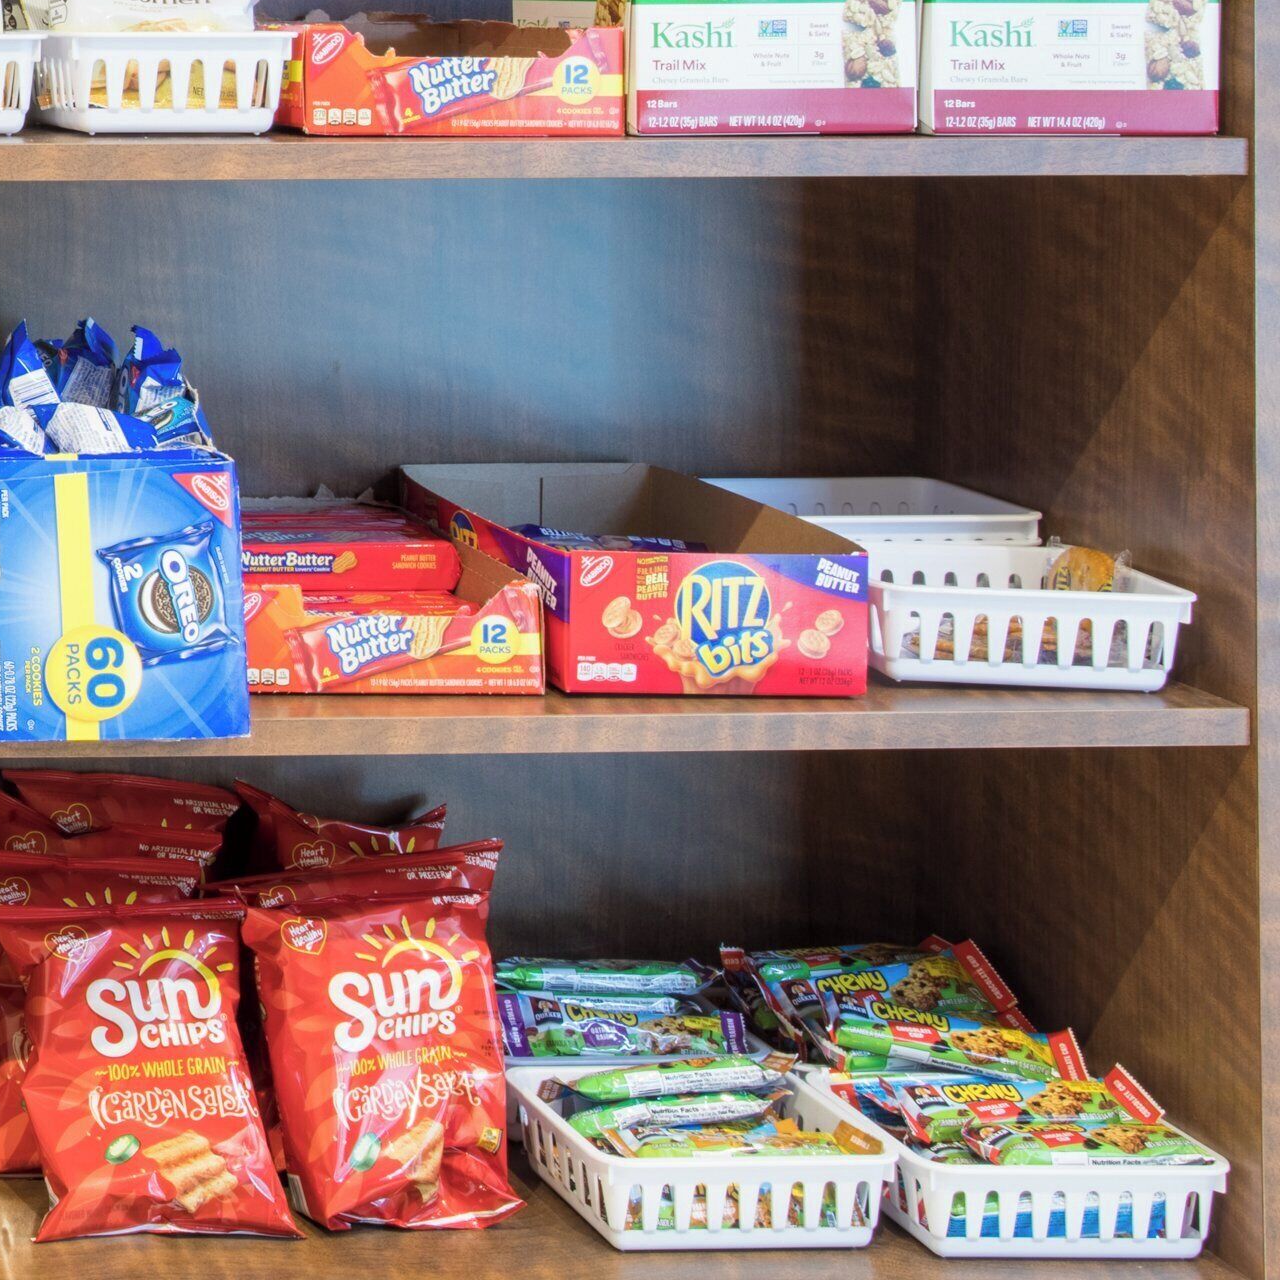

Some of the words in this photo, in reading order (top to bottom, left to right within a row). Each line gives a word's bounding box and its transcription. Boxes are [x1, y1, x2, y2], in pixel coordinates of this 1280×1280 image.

[651, 21, 733, 49] Kashi
[950, 20, 1033, 48] Kashi
[411, 57, 488, 90] Nutter
[564, 64, 588, 84] 12
[652, 59, 680, 71] Trail
[682, 59, 706, 71] Mix
[423, 71, 496, 115] Butter
[561, 86, 592, 95] PACKS
[194, 477, 226, 508] NABISCO
[815, 575, 860, 594] BUTTER
[817, 557, 860, 583] PEANUT
[158, 549, 200, 643] OREO
[680, 574, 766, 639] RITZ
[697, 630, 771, 674] bits
[65, 642, 82, 705] PACKS
[85, 636, 127, 708] 60
[816, 969, 888, 993] CHEWY
[86, 972, 222, 1058] Sun
[328, 967, 462, 1053] Sun
[140, 1019, 225, 1048] CHIPS
[376, 1010, 457, 1040] CHIPS
[142, 1058, 186, 1078] WHOLE
[188, 1056, 227, 1076] GRAIN
[941, 1082, 1024, 1104] CHEWY
